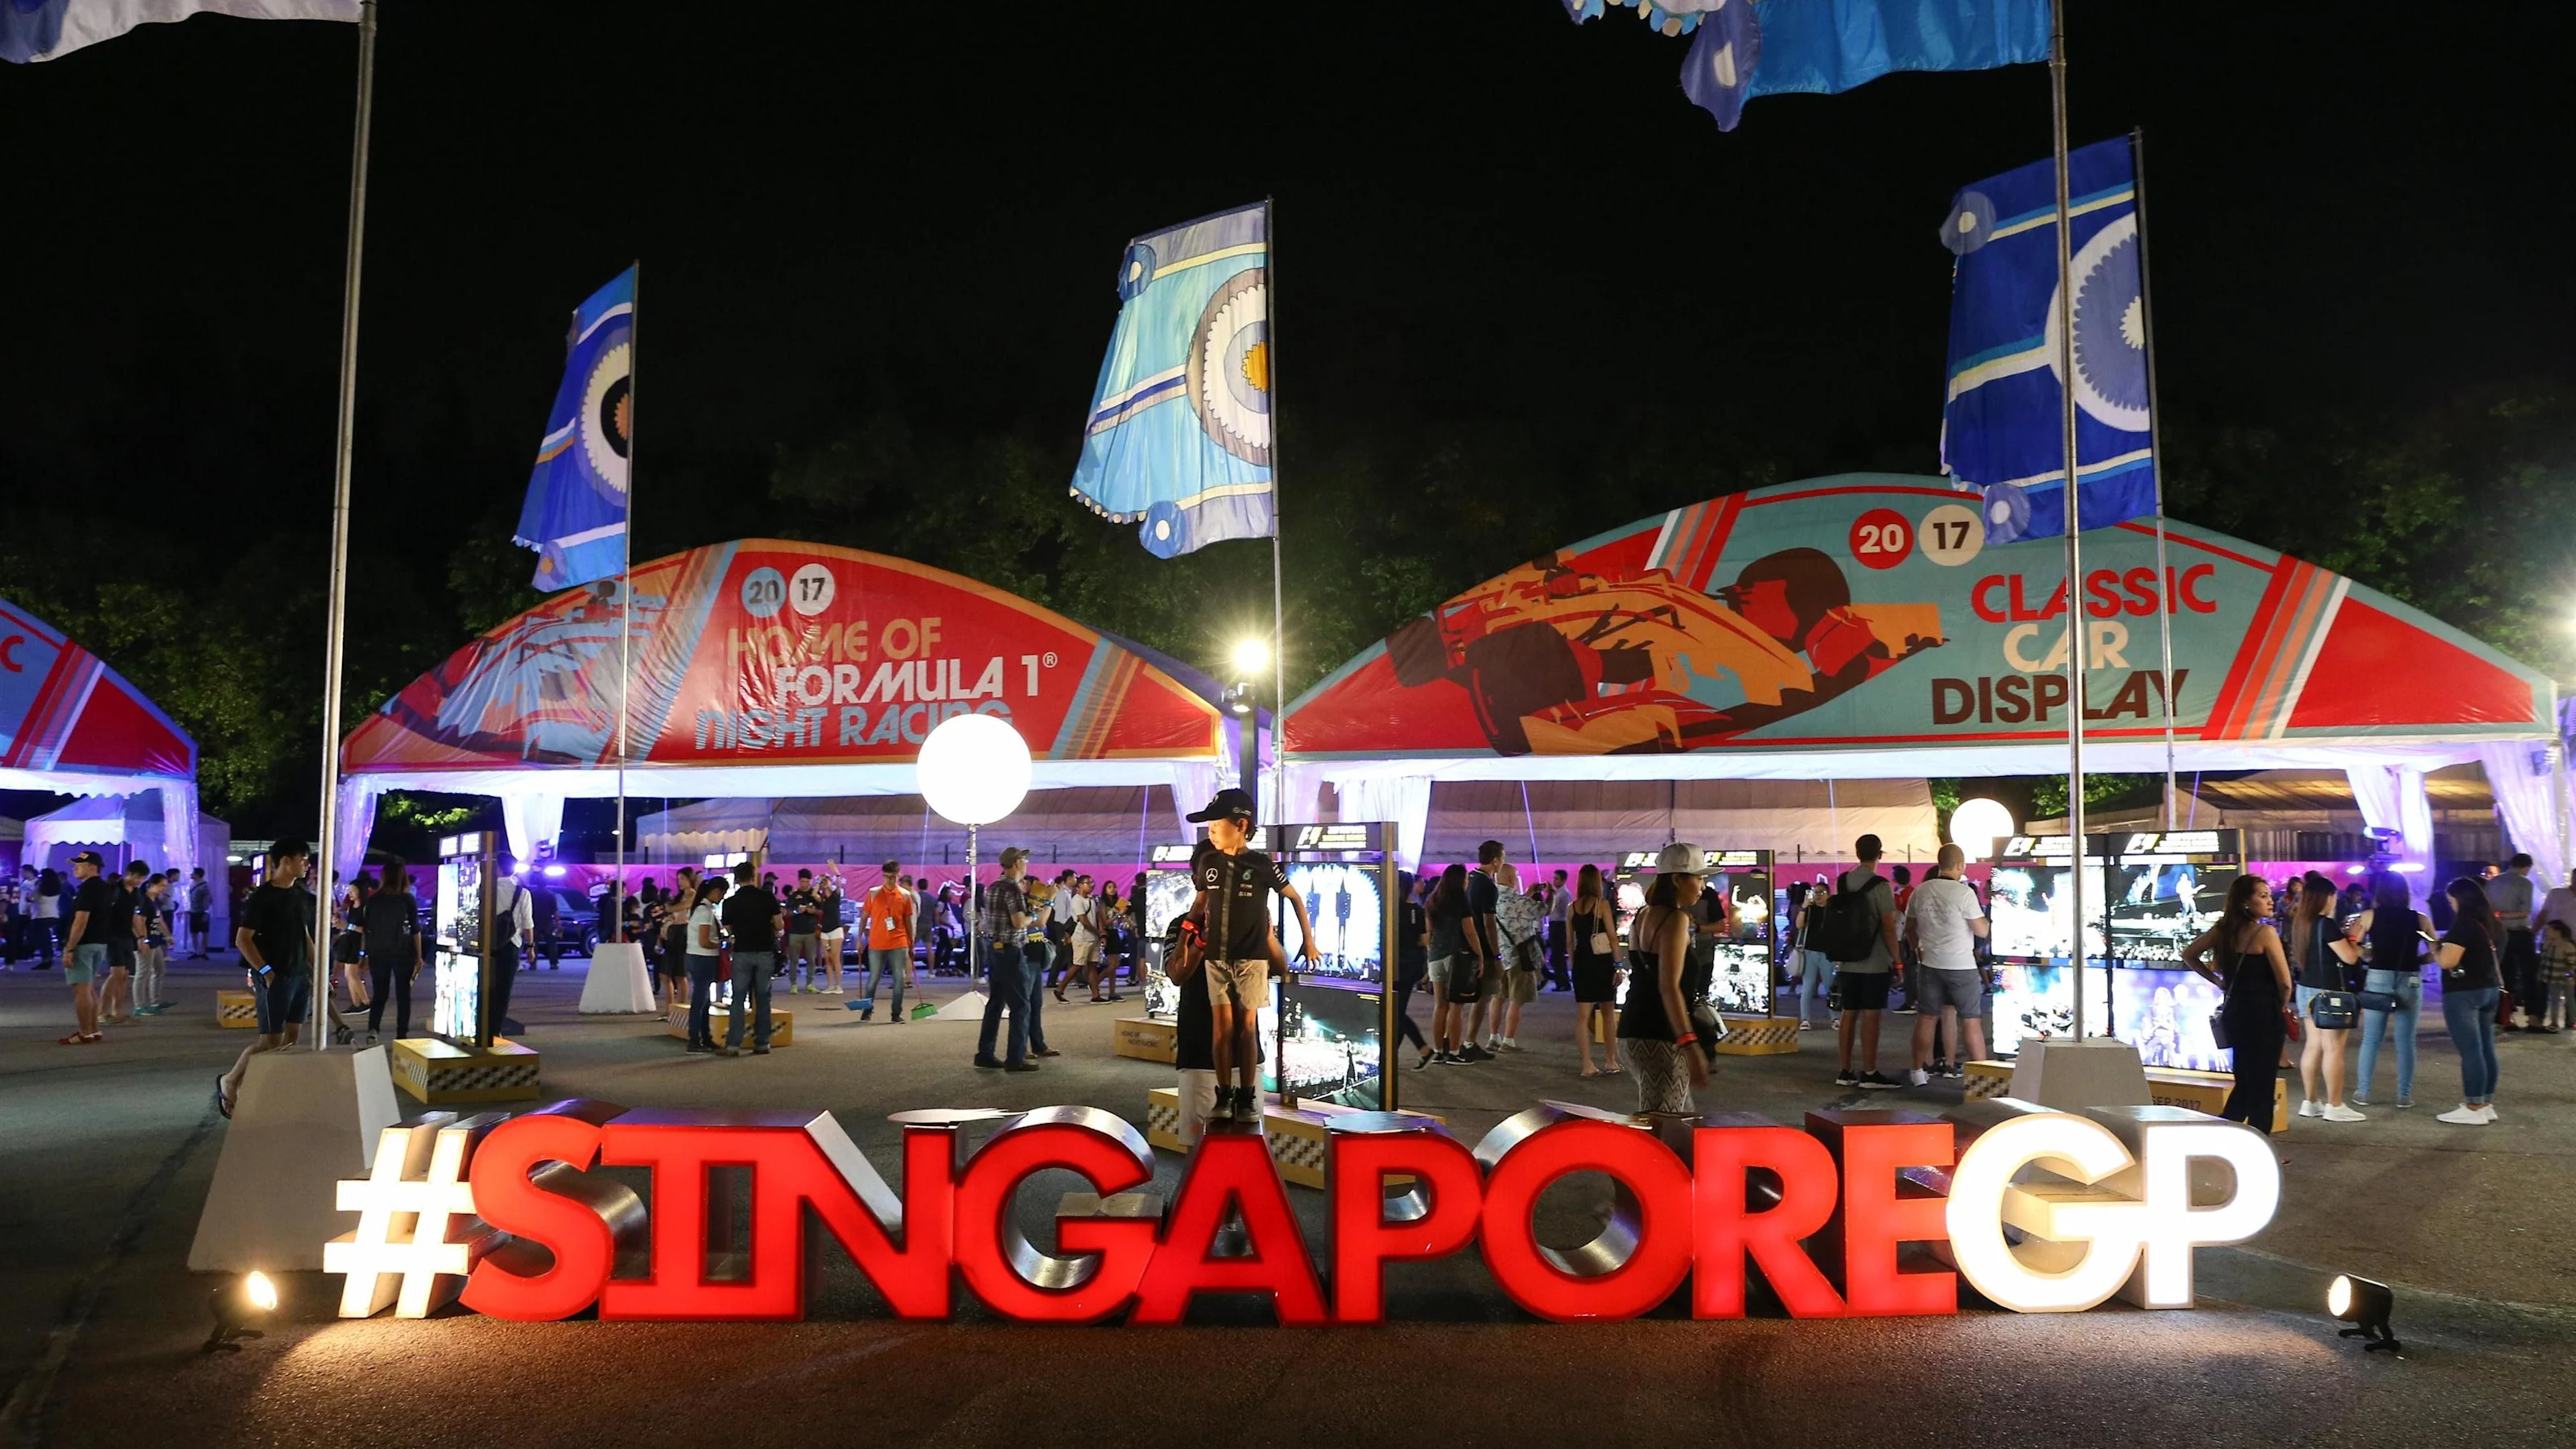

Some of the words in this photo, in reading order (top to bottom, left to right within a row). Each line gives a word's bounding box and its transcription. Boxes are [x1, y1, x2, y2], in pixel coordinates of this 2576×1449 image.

[1858, 523, 1905, 554] 20
[1933, 521, 1970, 551] 17
[748, 580, 779, 605] 20
[799, 577, 826, 601] 17
[1971, 563, 2216, 623] CLASSIC
[727, 621, 868, 667] HOME
[882, 617, 942, 658] OF
[2003, 621, 2130, 672] CAR
[774, 656, 1003, 708] FORMULA
[1931, 668, 2190, 724] DISPLAY
[324, 1114, 2281, 1324] #SINGAPOREGP
